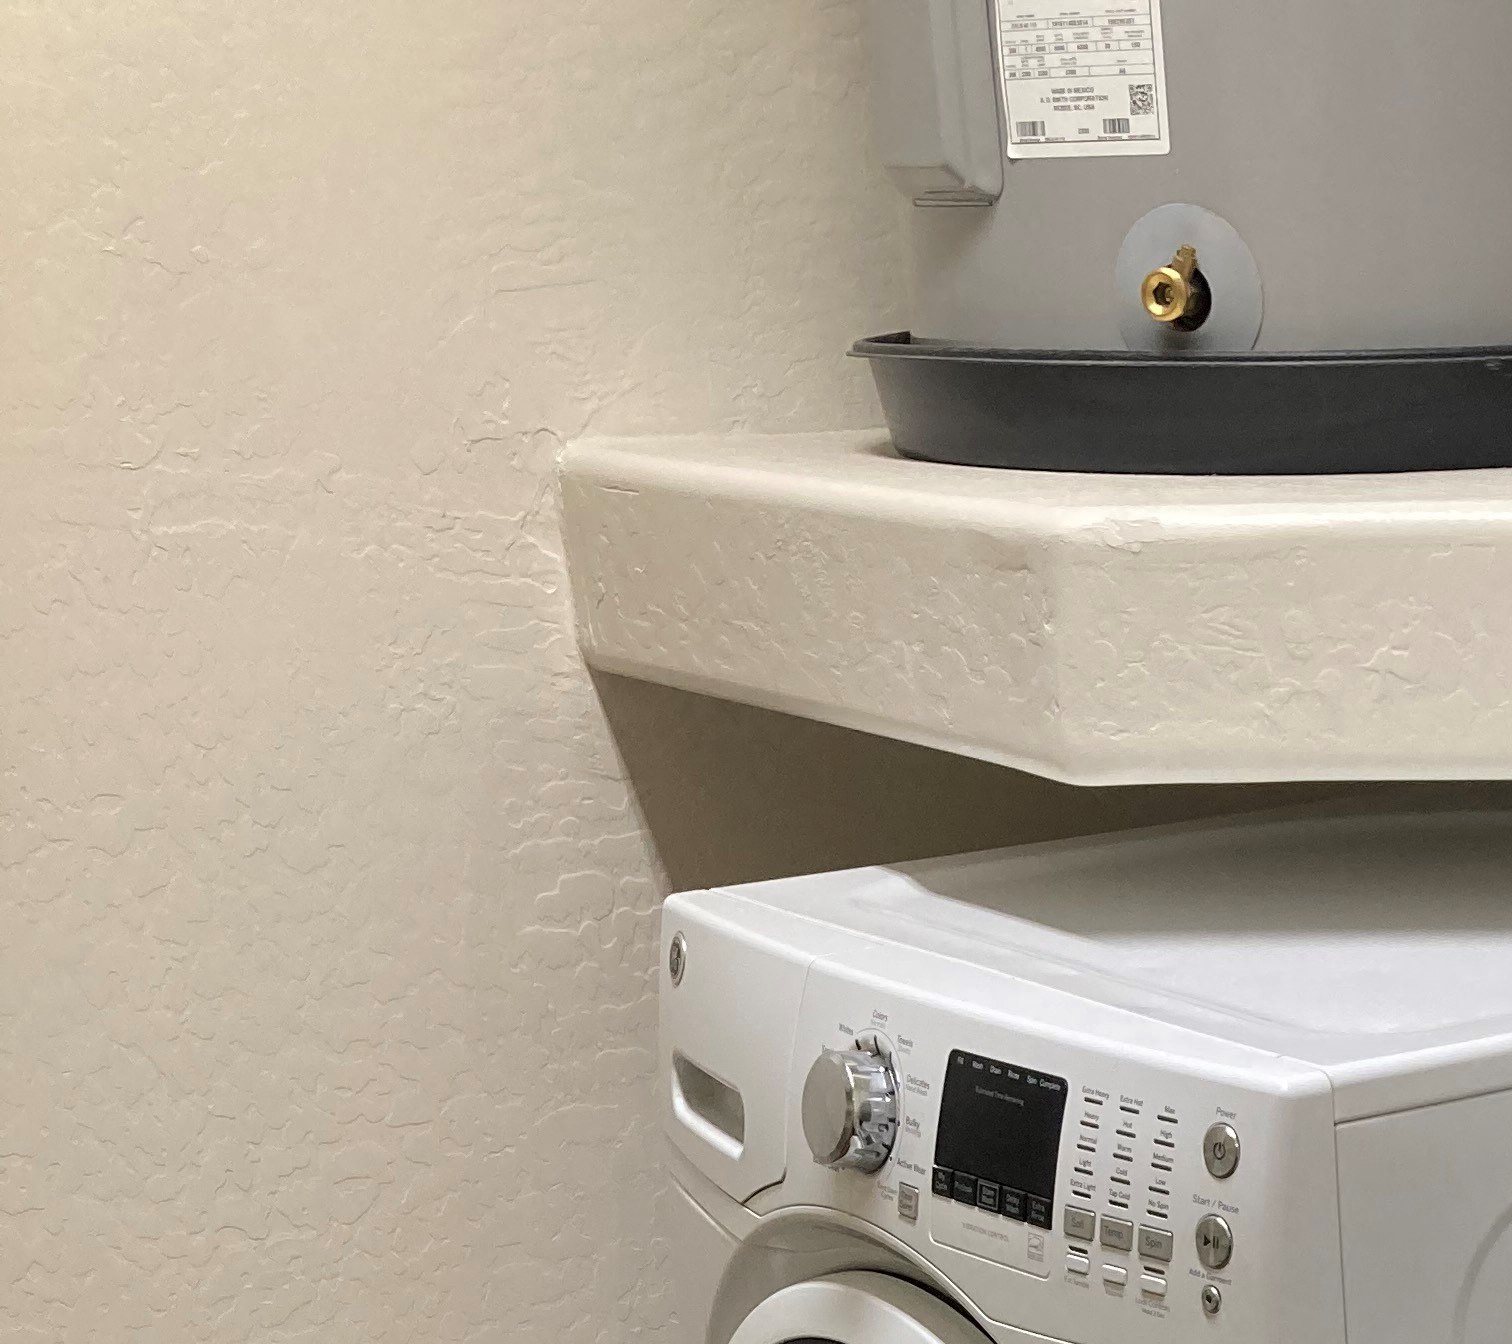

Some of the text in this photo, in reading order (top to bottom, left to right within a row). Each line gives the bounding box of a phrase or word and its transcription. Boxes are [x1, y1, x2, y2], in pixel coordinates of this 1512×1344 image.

[1216, 1106, 1237, 1120] Power
[1078, 1158, 1092, 1168] Light
[1115, 1167, 1128, 1176] Cold
[1192, 1193, 1211, 1206] Start
[1217, 1201, 1240, 1215] Pause
[1103, 1225, 1124, 1240] Temp
[1145, 1236, 1163, 1249] Spin
